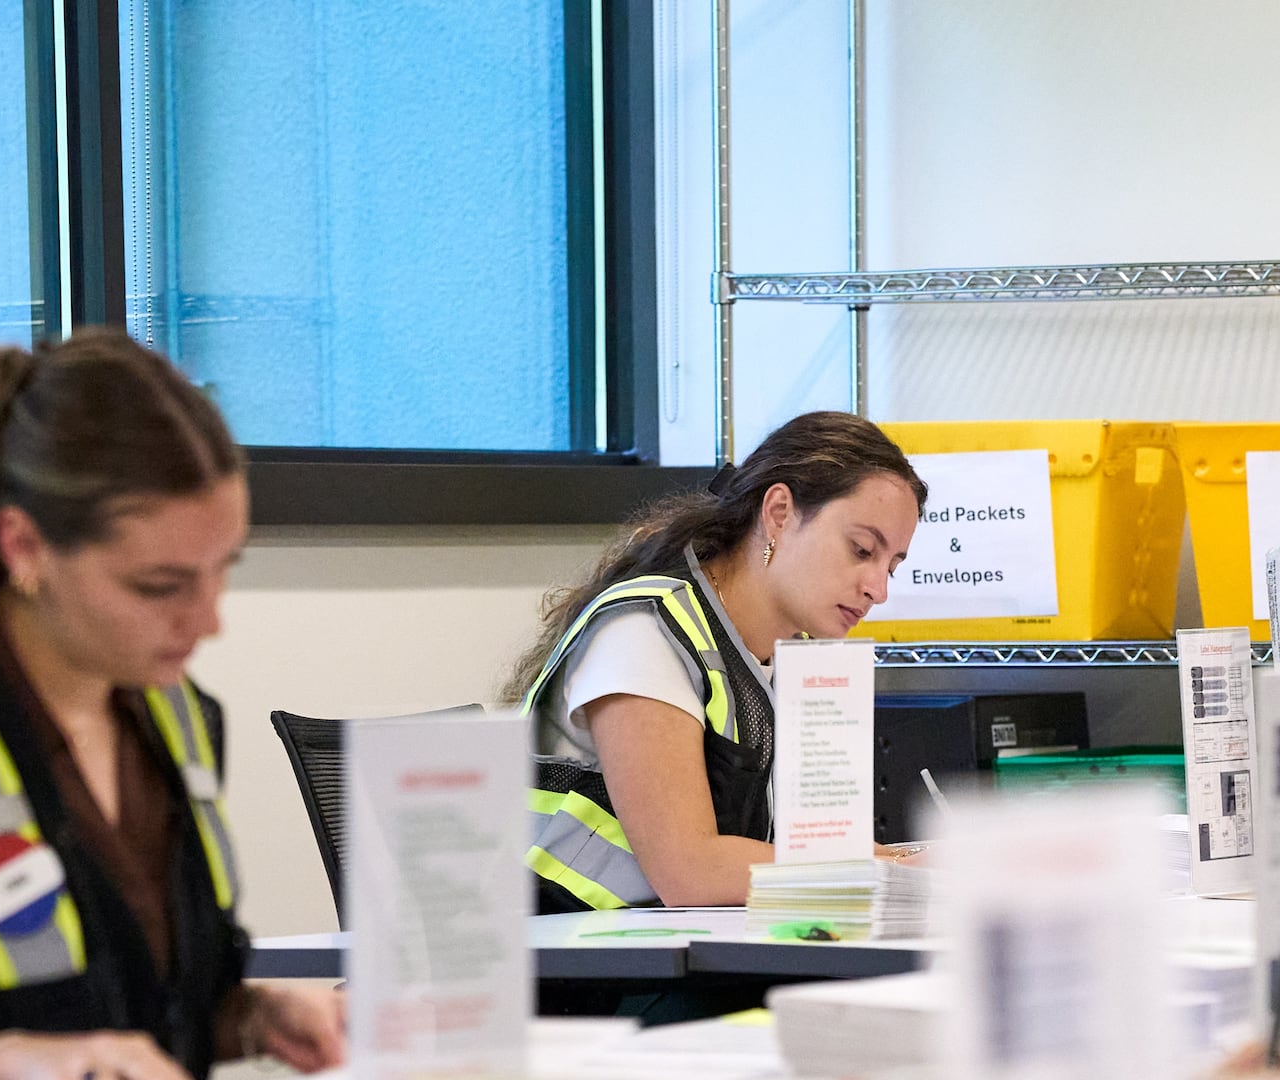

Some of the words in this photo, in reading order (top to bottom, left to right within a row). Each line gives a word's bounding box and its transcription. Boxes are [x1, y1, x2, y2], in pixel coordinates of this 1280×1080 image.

[955, 505, 1026, 522] Packets
[949, 537, 962, 553] &
[912, 568, 1004, 586] Envelopes
